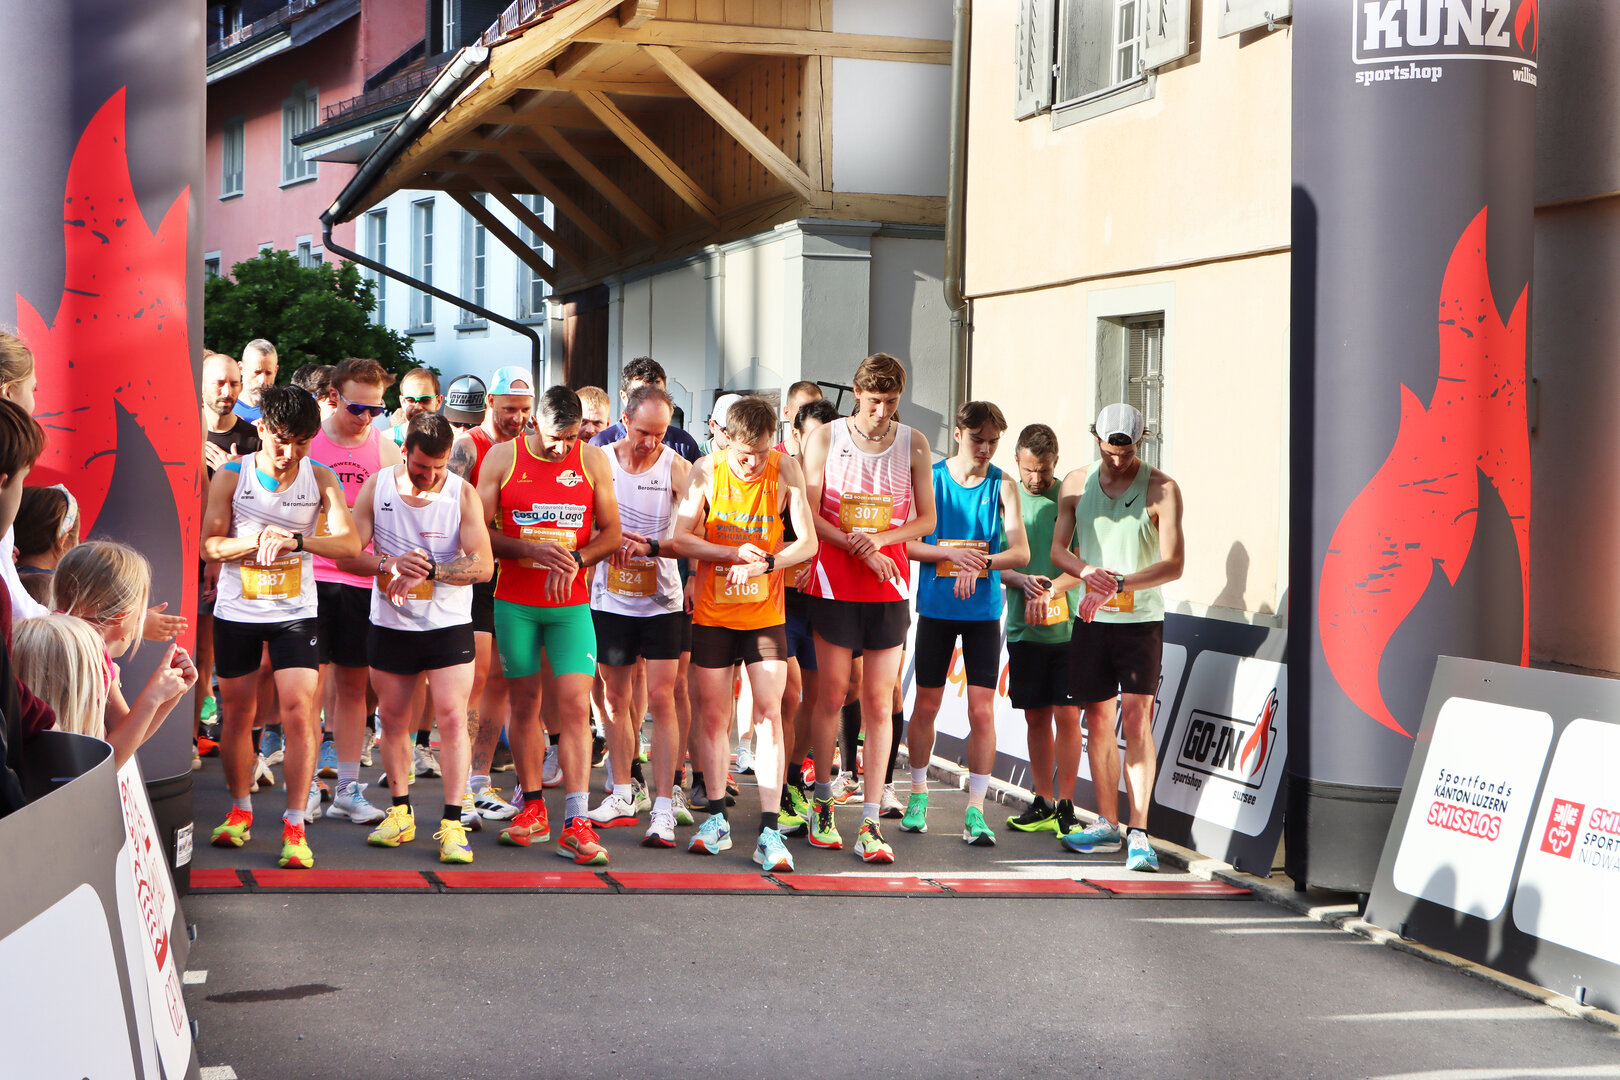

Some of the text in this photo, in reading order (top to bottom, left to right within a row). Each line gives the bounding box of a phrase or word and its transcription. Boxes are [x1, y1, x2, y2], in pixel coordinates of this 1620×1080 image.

[1363, 0, 1511, 50] KUNZ
[1355, 63, 1443, 86] sportshop
[542, 511, 556, 520] do
[560, 511, 582, 522] Lago
[854, 507, 879, 520] 307
[716, 532, 768, 541] SCHUMACHER
[723, 526, 768, 534] INTERSPORT
[257, 573, 286, 586] 387
[619, 571, 642, 584] 324
[725, 583, 759, 596] 3108
[1183, 719, 1245, 771] GO-IN
[1172, 771, 1202, 791] sportshop
[1439, 768, 1512, 797] Sportfonds
[1232, 790, 1257, 805] sursee
[1434, 784, 1508, 813] KANTON LUZERN
[1427, 801, 1502, 841] SWISSLOS
[1589, 808, 1620, 836] SWI
